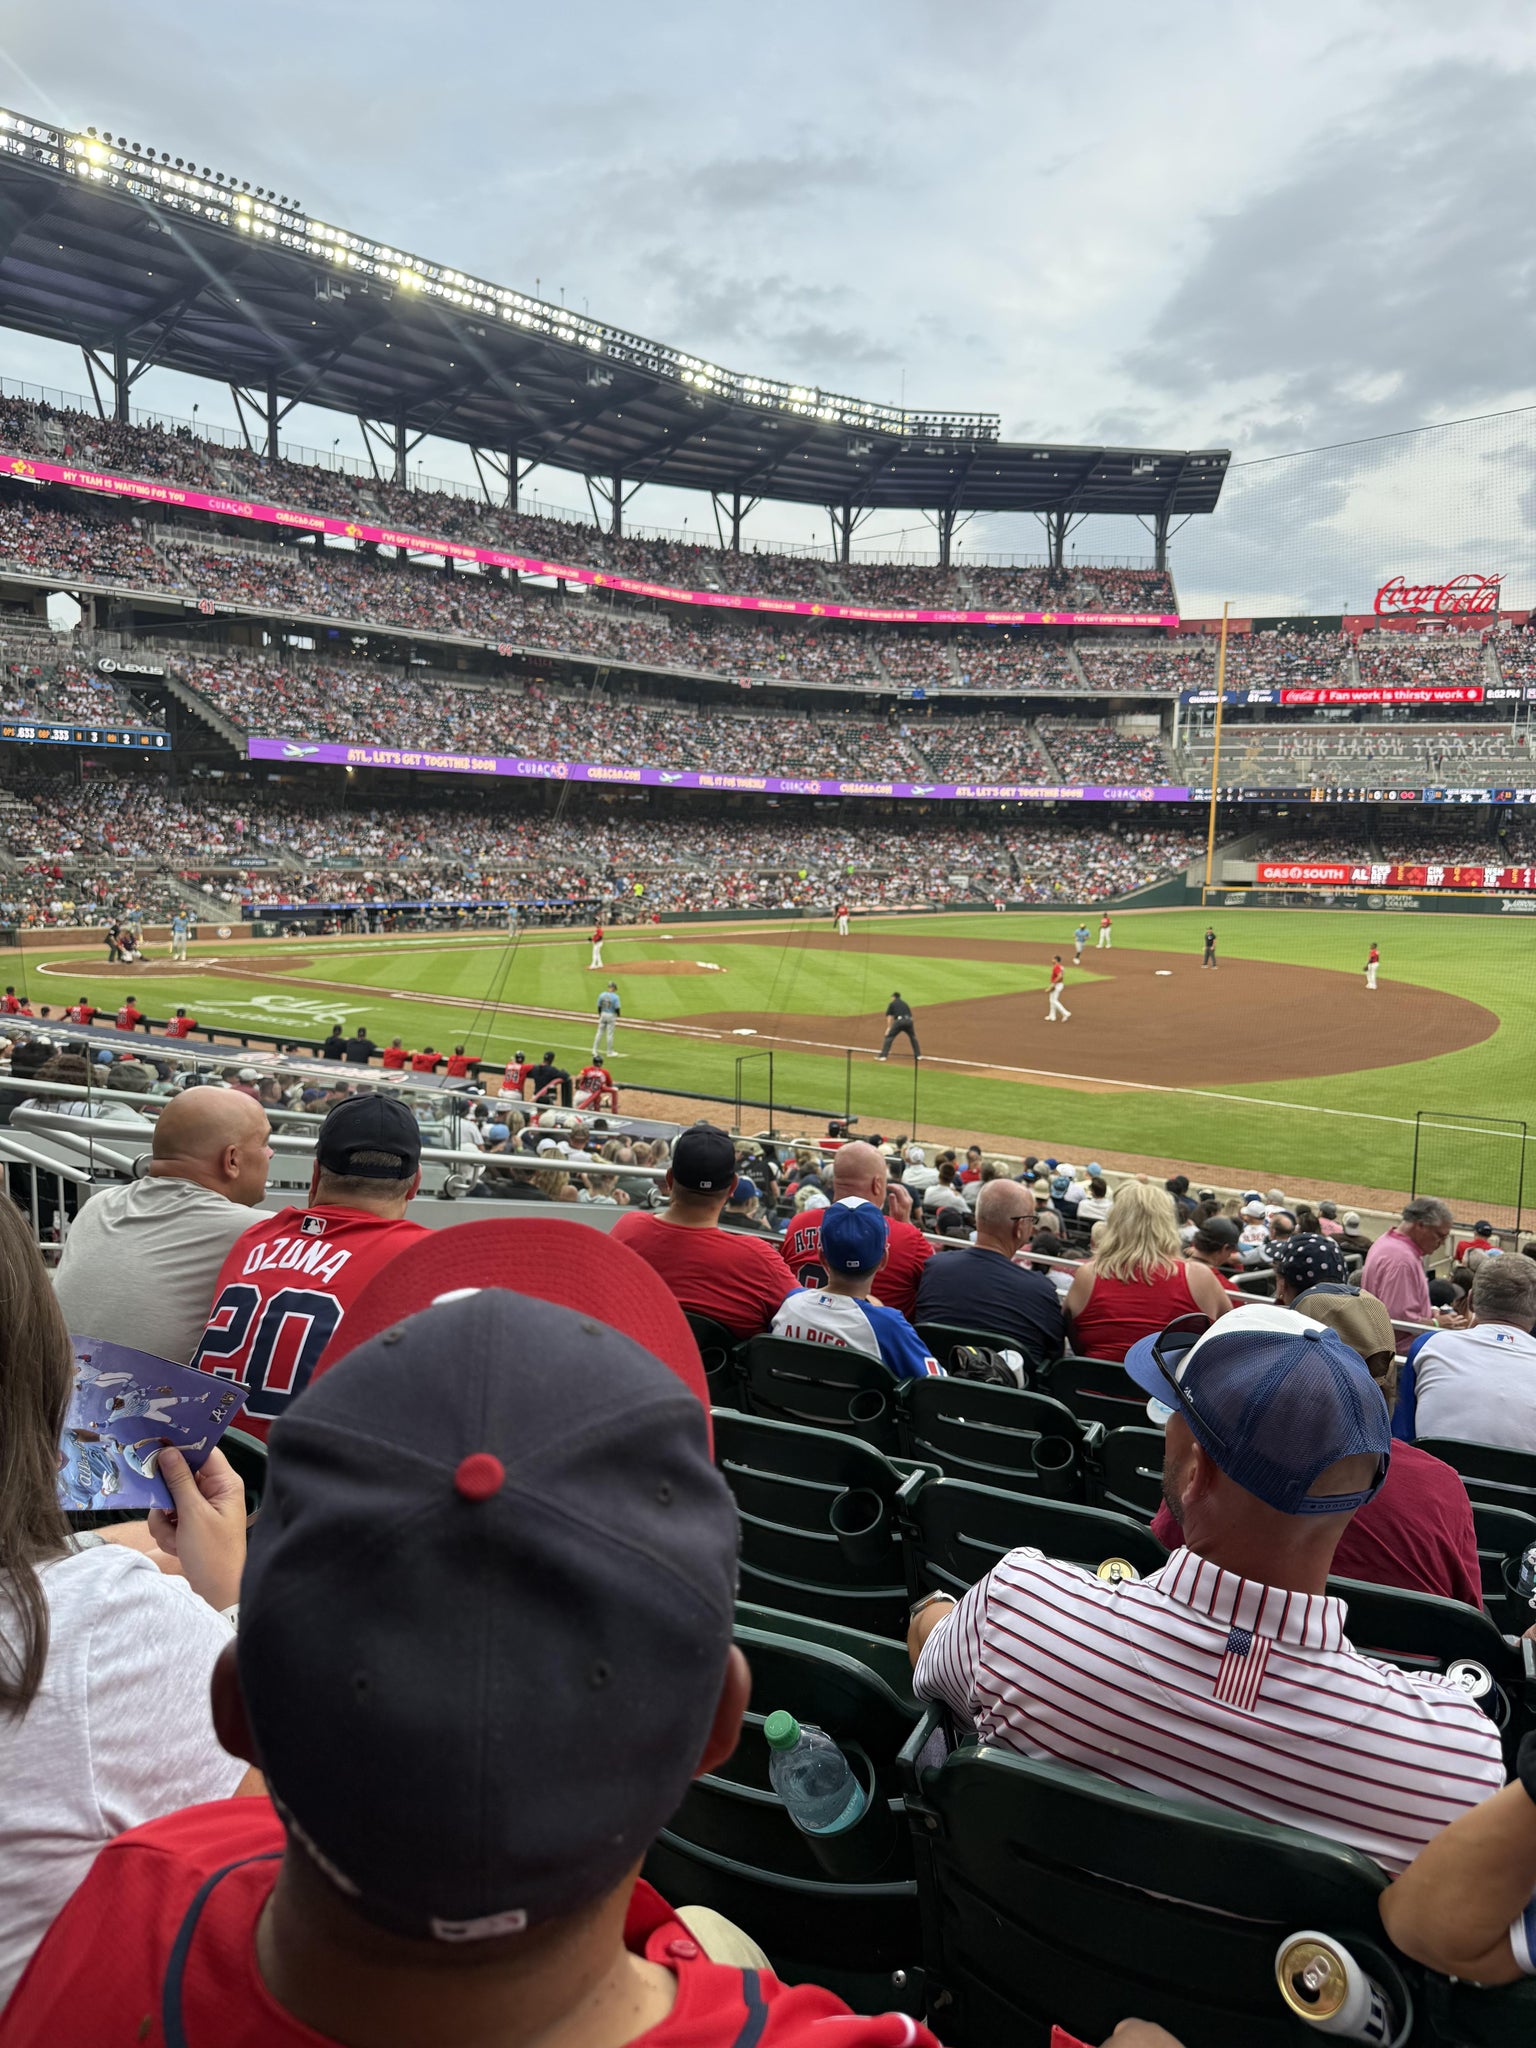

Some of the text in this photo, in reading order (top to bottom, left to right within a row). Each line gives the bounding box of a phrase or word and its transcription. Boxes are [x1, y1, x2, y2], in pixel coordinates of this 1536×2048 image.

[63, 471, 185, 502] MY TEAM IS WAITING FOR YOU
[198, 598, 215, 615] 41
[117, 662, 164, 675] LEXUS
[1330, 690, 1464, 702] Fan work is thirsty work
[1506, 689, 1520, 698] PM
[1188, 696, 1228, 704] CHANGEP
[90, 732, 98, 742] 3
[123, 734, 130, 744] 2
[156, 736, 164, 747] 0
[1278, 738, 1509, 756] HANK AARON TERRACE
[348, 749, 496, 772] ATL, LET'S GET TOGETHER SOON
[1374, 791, 1382, 800] 0
[1389, 791, 1396, 800] 0
[1264, 868, 1344, 880] GAS SOUTH
[1351, 868, 1369, 880] AL
[1372, 865, 1391, 873] CWS
[1428, 866, 1443, 874] CIN
[1484, 868, 1504, 876] WSH
[1427, 874, 1444, 882] NYY
[242, 1238, 352, 1284] OZUNA
[190, 1283, 344, 1420] 20
